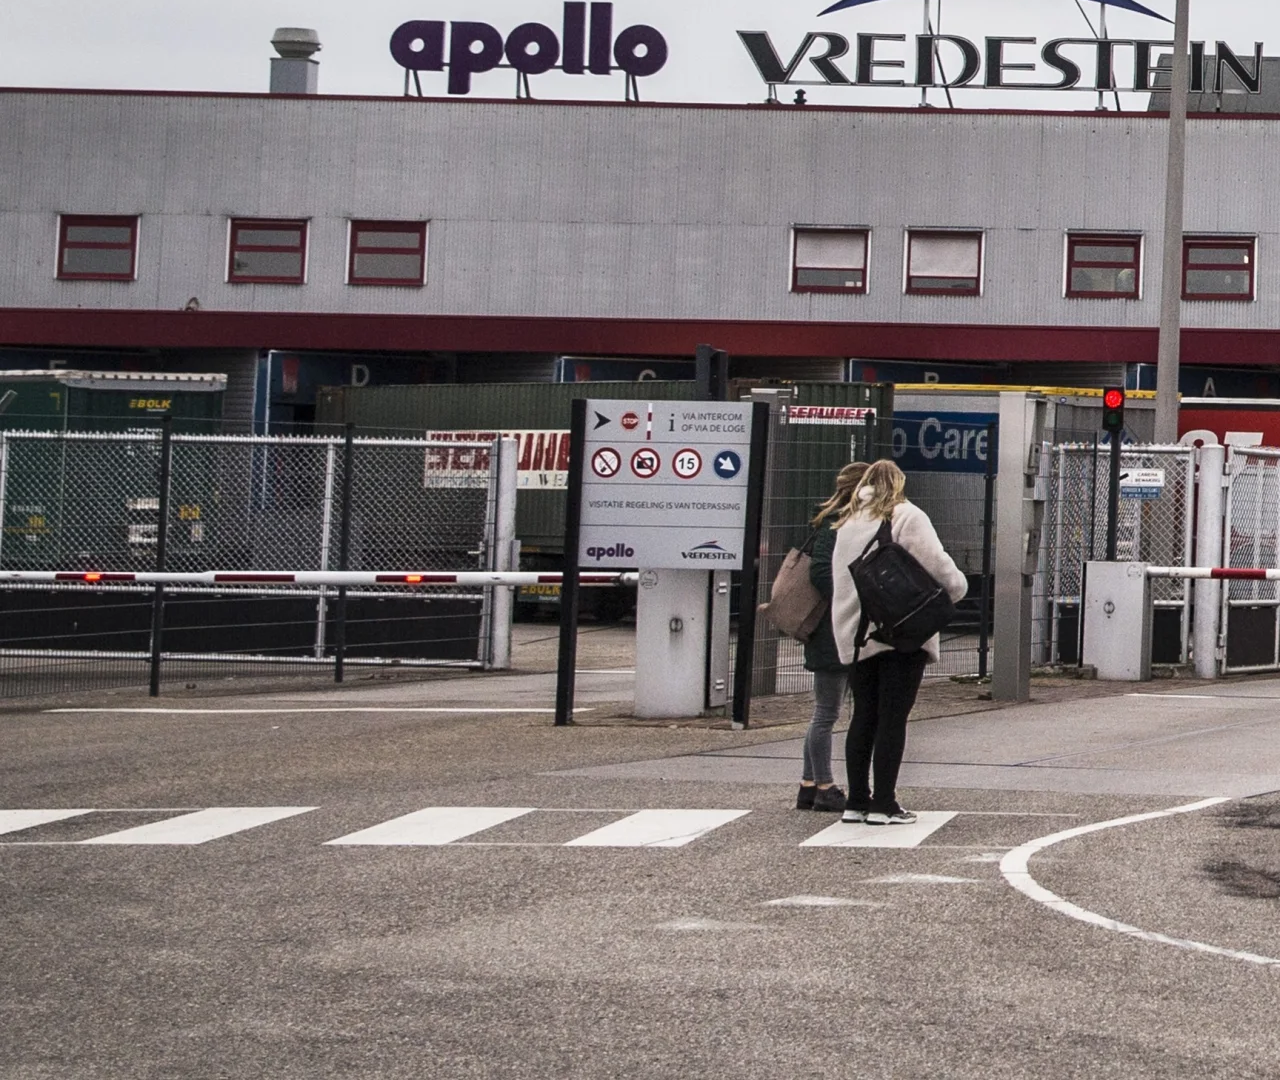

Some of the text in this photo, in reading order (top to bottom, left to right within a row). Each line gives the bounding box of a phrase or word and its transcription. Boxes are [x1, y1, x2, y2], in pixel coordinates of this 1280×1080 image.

[390, 1, 668, 94] apollo
[736, 30, 1264, 94] VREDESTEIN
[351, 364, 370, 387] D
[1202, 376, 1217, 398] A
[137, 399, 172, 409] BOLK
[622, 417, 639, 425] STOP
[682, 412, 743, 421] VIA INTERCOM
[681, 423, 746, 433] OF VIA DE LOGE
[918, 417, 988, 461] Care
[678, 457, 695, 470] 15
[589, 500, 741, 511] VISITATIE REGELING IS VAN TOEPASSING
[586, 543, 635, 561] apollo
[681, 551, 737, 560] VREDESTEIN
